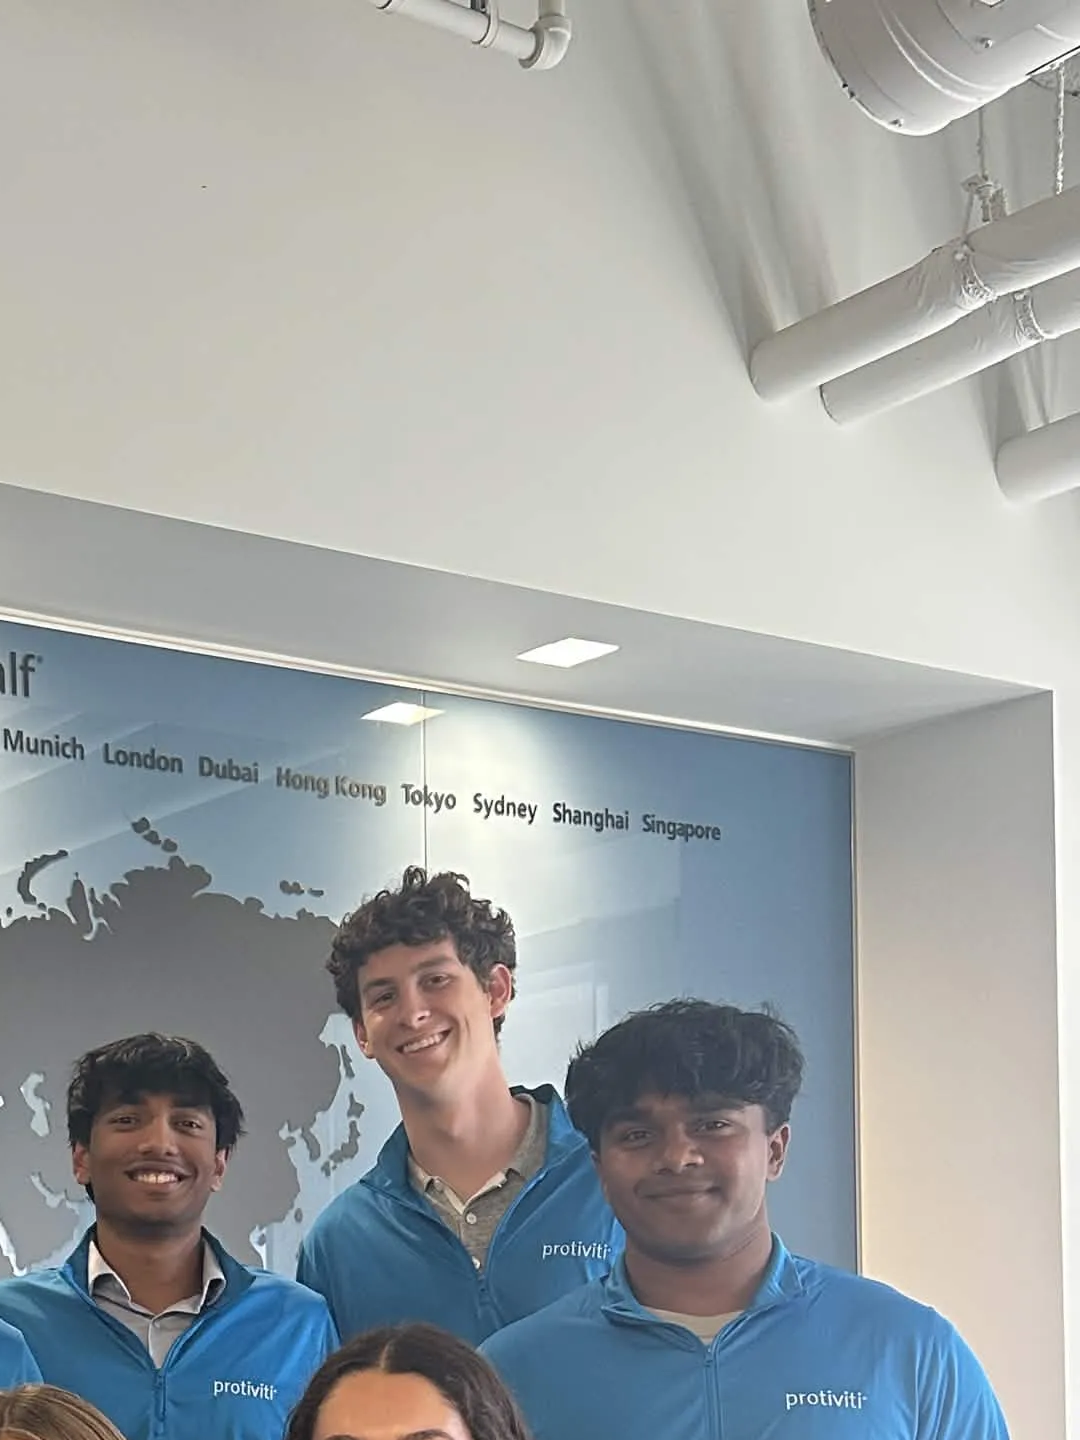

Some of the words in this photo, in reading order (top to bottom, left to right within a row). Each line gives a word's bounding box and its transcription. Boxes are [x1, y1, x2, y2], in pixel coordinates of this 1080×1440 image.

[3, 728, 85, 760] Munich
[103, 743, 183, 774] London
[198, 756, 259, 784] Dubai
[276, 767, 329, 798] Hong
[335, 776, 387, 806] Kong
[401, 783, 457, 814] Tokyo
[472, 793, 537, 825] Sydney
[553, 803, 629, 832] Shanghai
[642, 814, 721, 842] Singapore
[542, 1241, 609, 1260] protiviti
[214, 1380, 275, 1400] protiviti
[785, 1390, 863, 1410] protiviti
